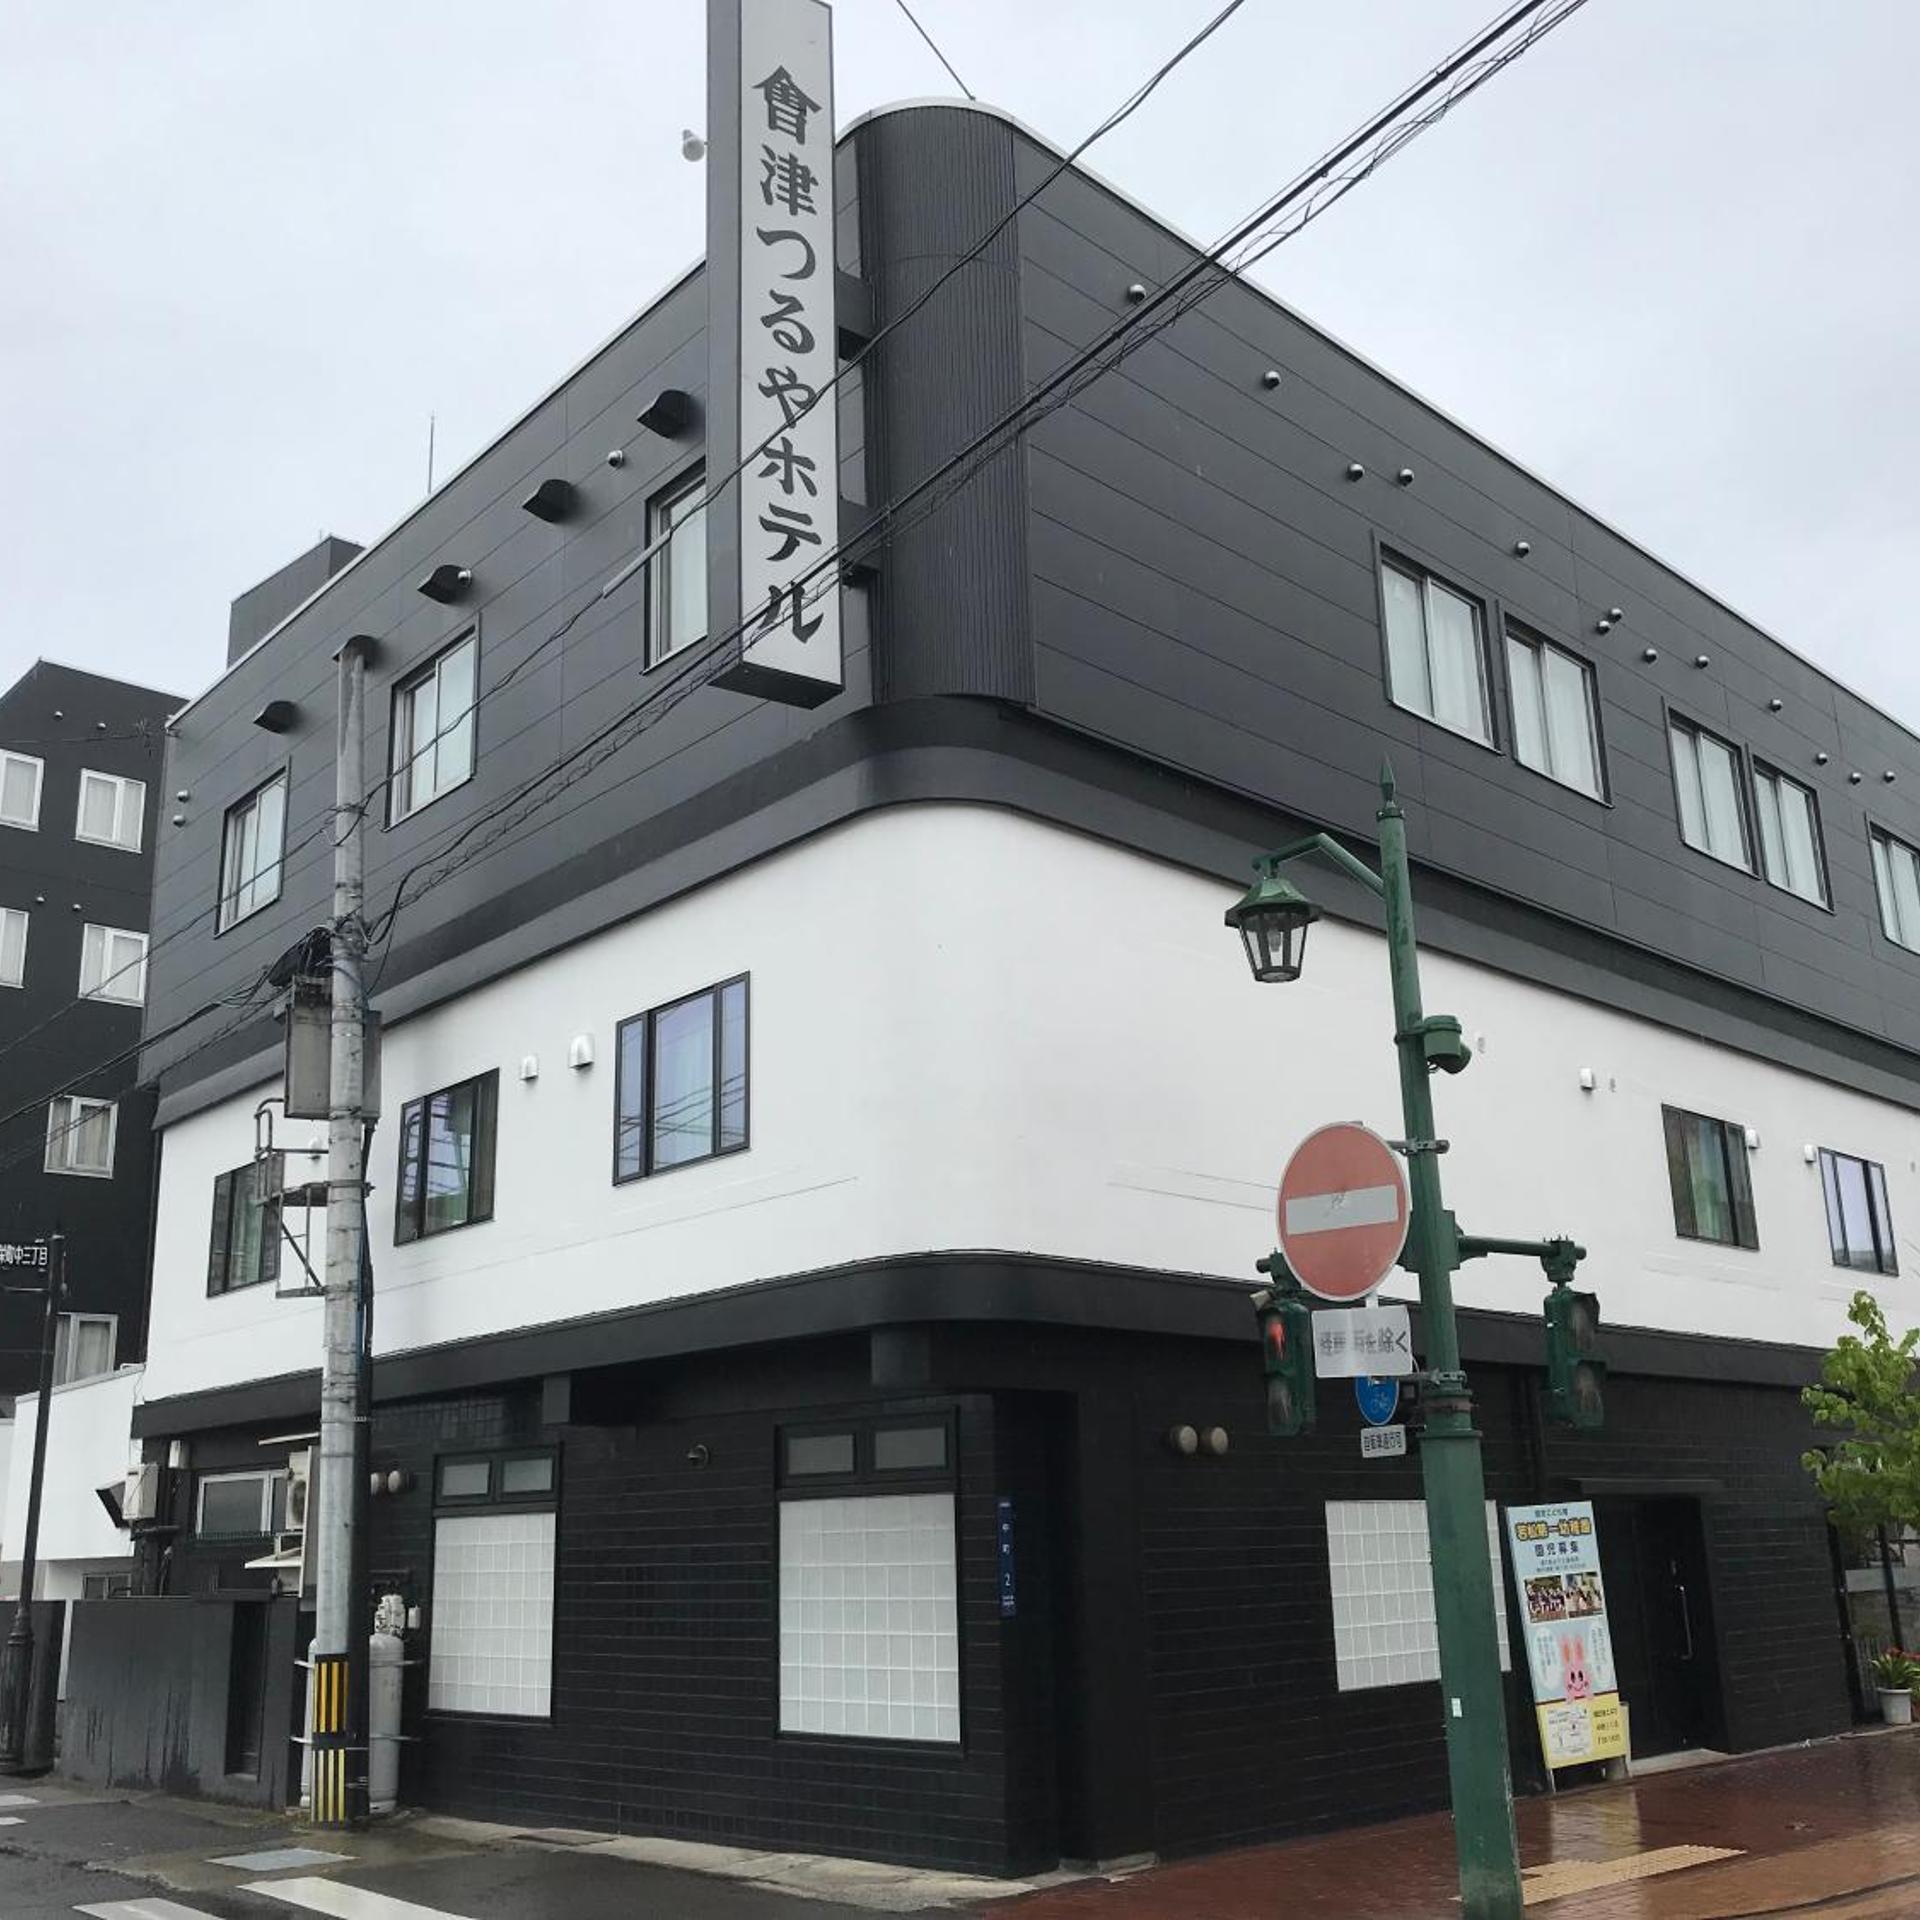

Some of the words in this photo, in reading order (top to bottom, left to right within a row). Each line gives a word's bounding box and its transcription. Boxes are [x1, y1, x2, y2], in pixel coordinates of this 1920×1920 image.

[752, 65, 823, 643] 會津つるやホテル
